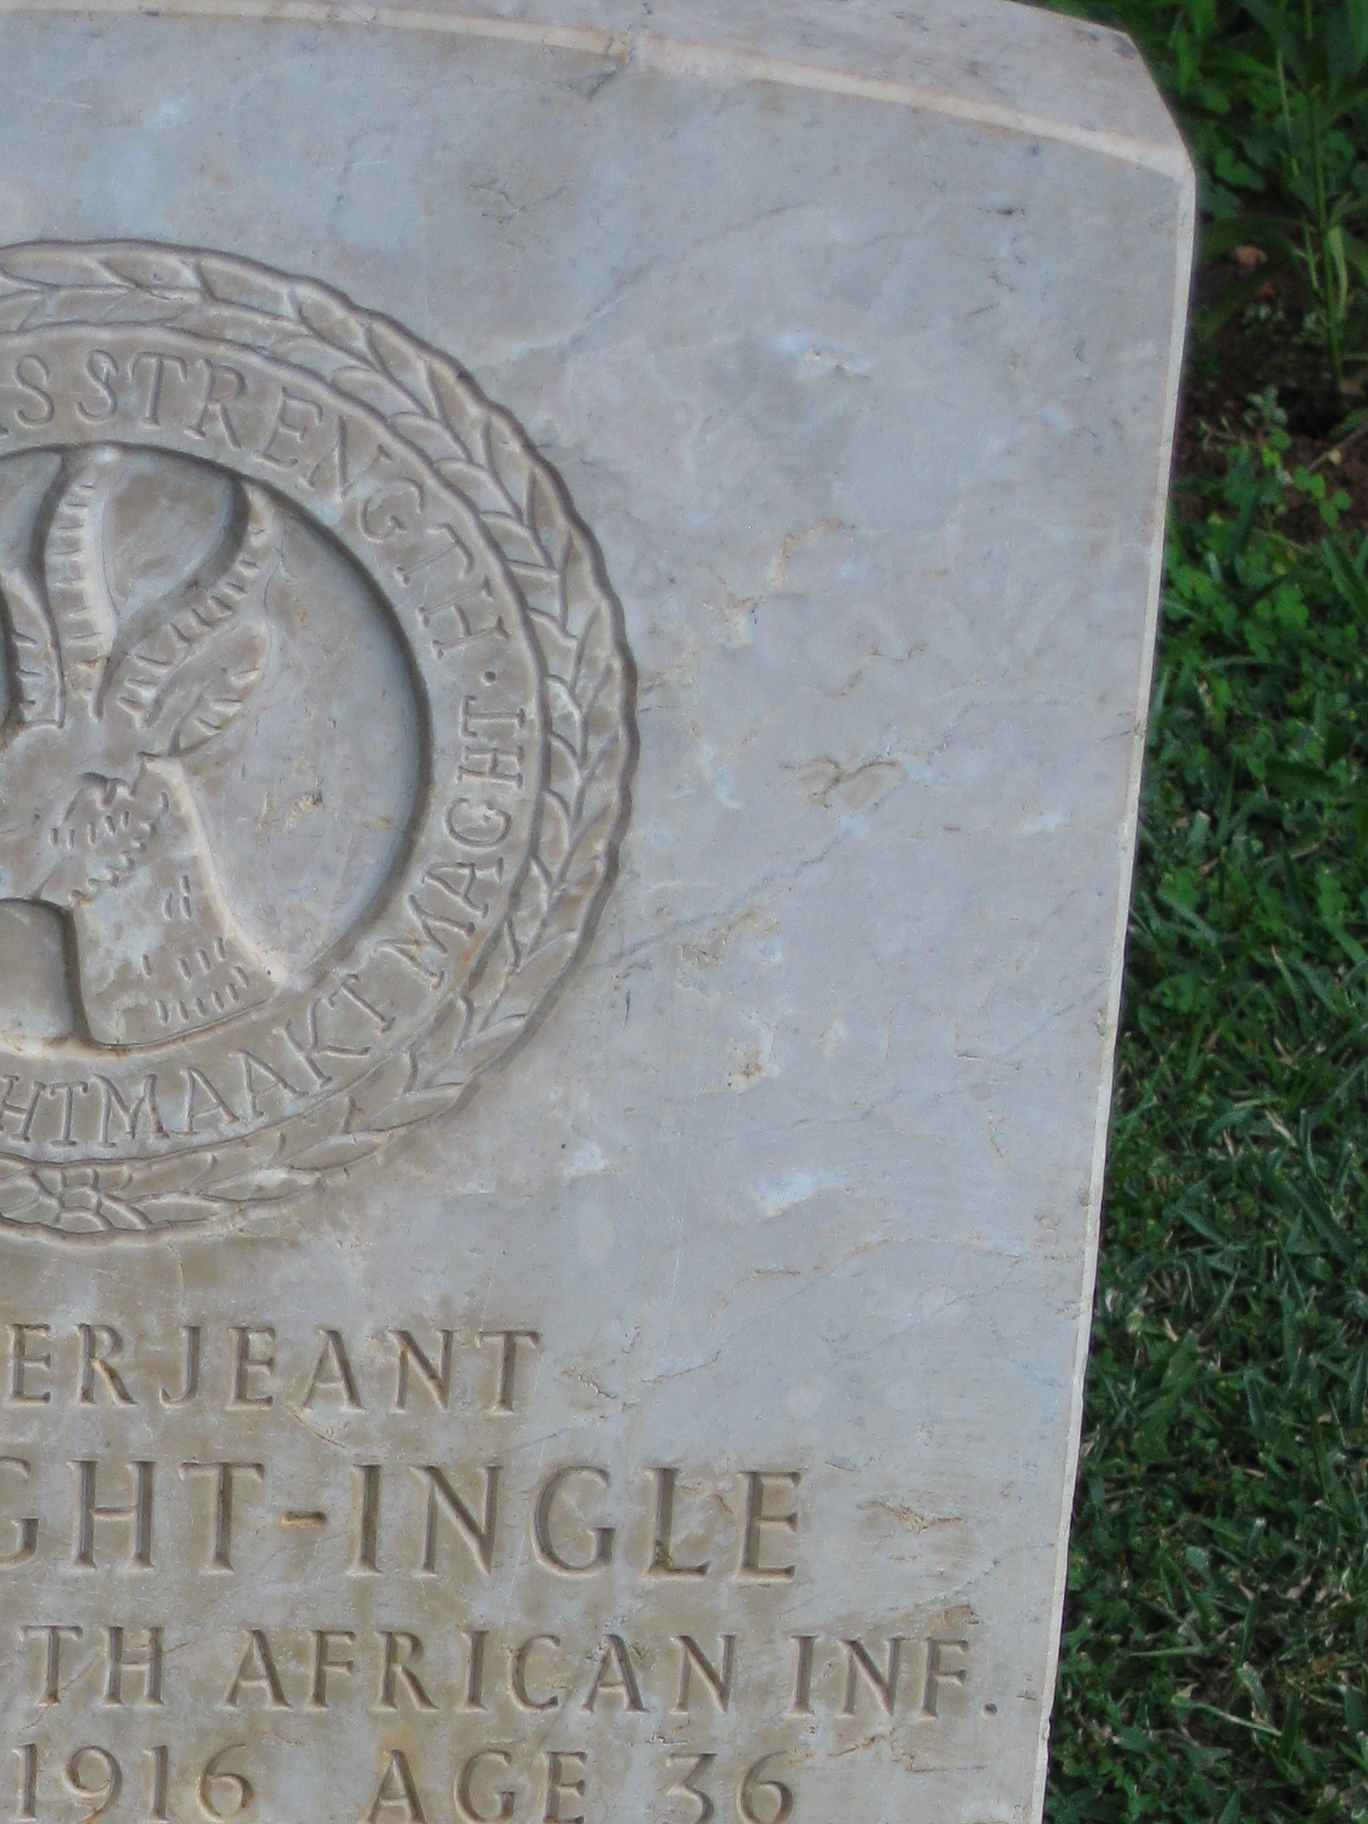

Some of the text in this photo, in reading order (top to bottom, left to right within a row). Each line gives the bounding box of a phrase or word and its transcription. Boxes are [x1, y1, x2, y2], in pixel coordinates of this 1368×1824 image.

[75, 349, 509, 658] STRENGTH
[92, 973, 396, 1149] MAAKT
[223, 1627, 739, 1716] AFRICAN
[788, 1633, 998, 1718] INF.
[8, 1741, 255, 1824] 1916
